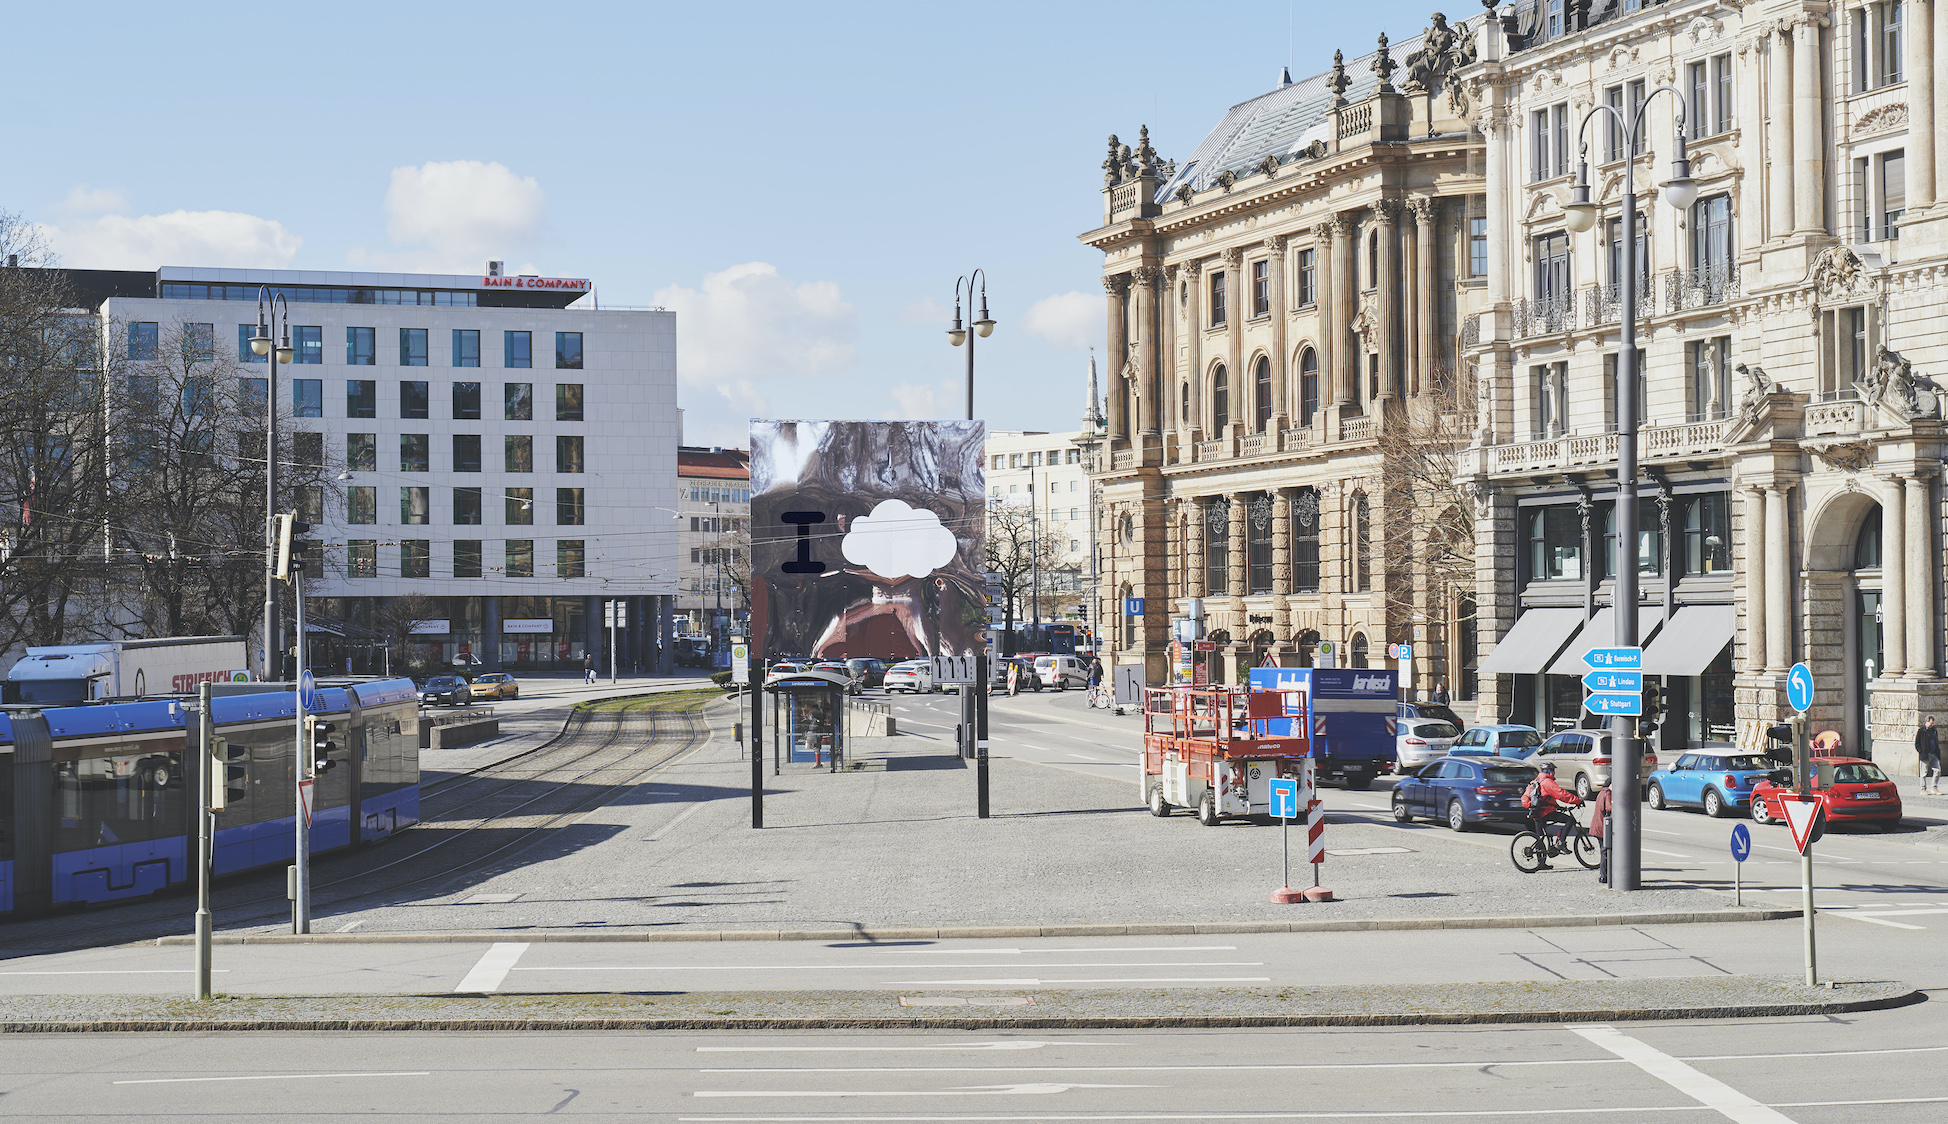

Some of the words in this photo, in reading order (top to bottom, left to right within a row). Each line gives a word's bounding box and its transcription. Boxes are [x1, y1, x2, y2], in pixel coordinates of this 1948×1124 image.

[484, 278, 512, 287] BAIN
[516, 279, 524, 288] &
[527, 279, 586, 289] COMPANY
[781, 511, 826, 574] I
[1130, 601, 1140, 613] U
[1401, 647, 1408, 659] P
[1610, 700, 1631, 708] Stuttgart
